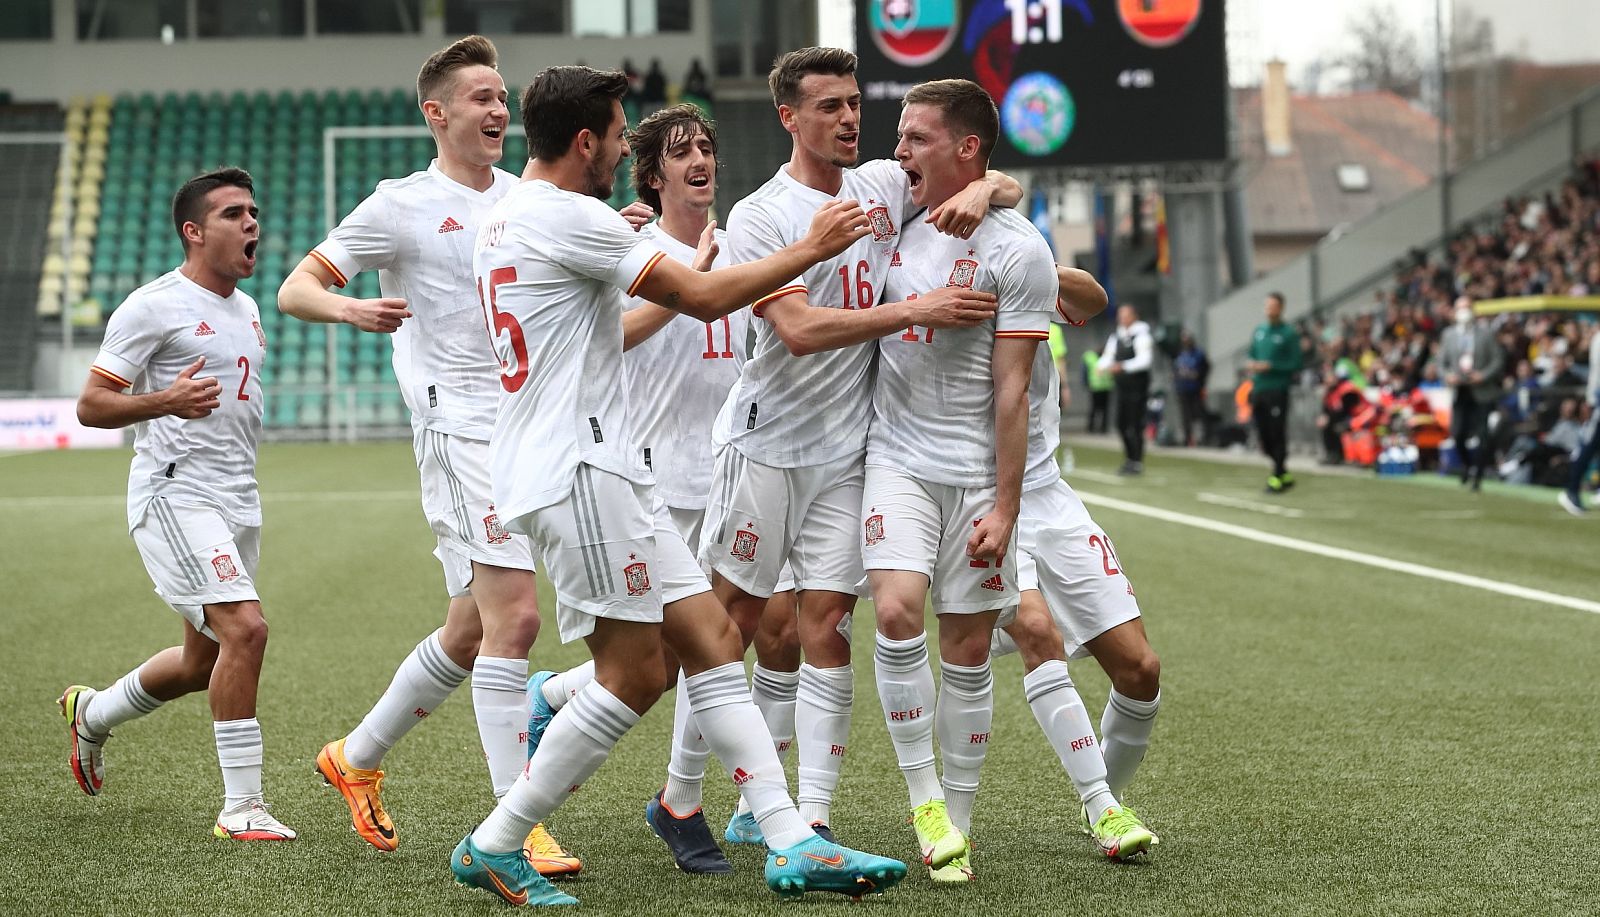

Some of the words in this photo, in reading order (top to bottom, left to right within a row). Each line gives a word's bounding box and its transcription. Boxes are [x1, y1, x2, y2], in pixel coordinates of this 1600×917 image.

[438, 225, 464, 233] adidas
[839, 260, 874, 309] 16
[478, 266, 529, 393] 15
[703, 315, 733, 359] 11
[238, 356, 249, 401] 2
[981, 583, 1004, 592] adidas
[891, 707, 922, 721] RFEF
[1071, 736, 1093, 752] RFEF
